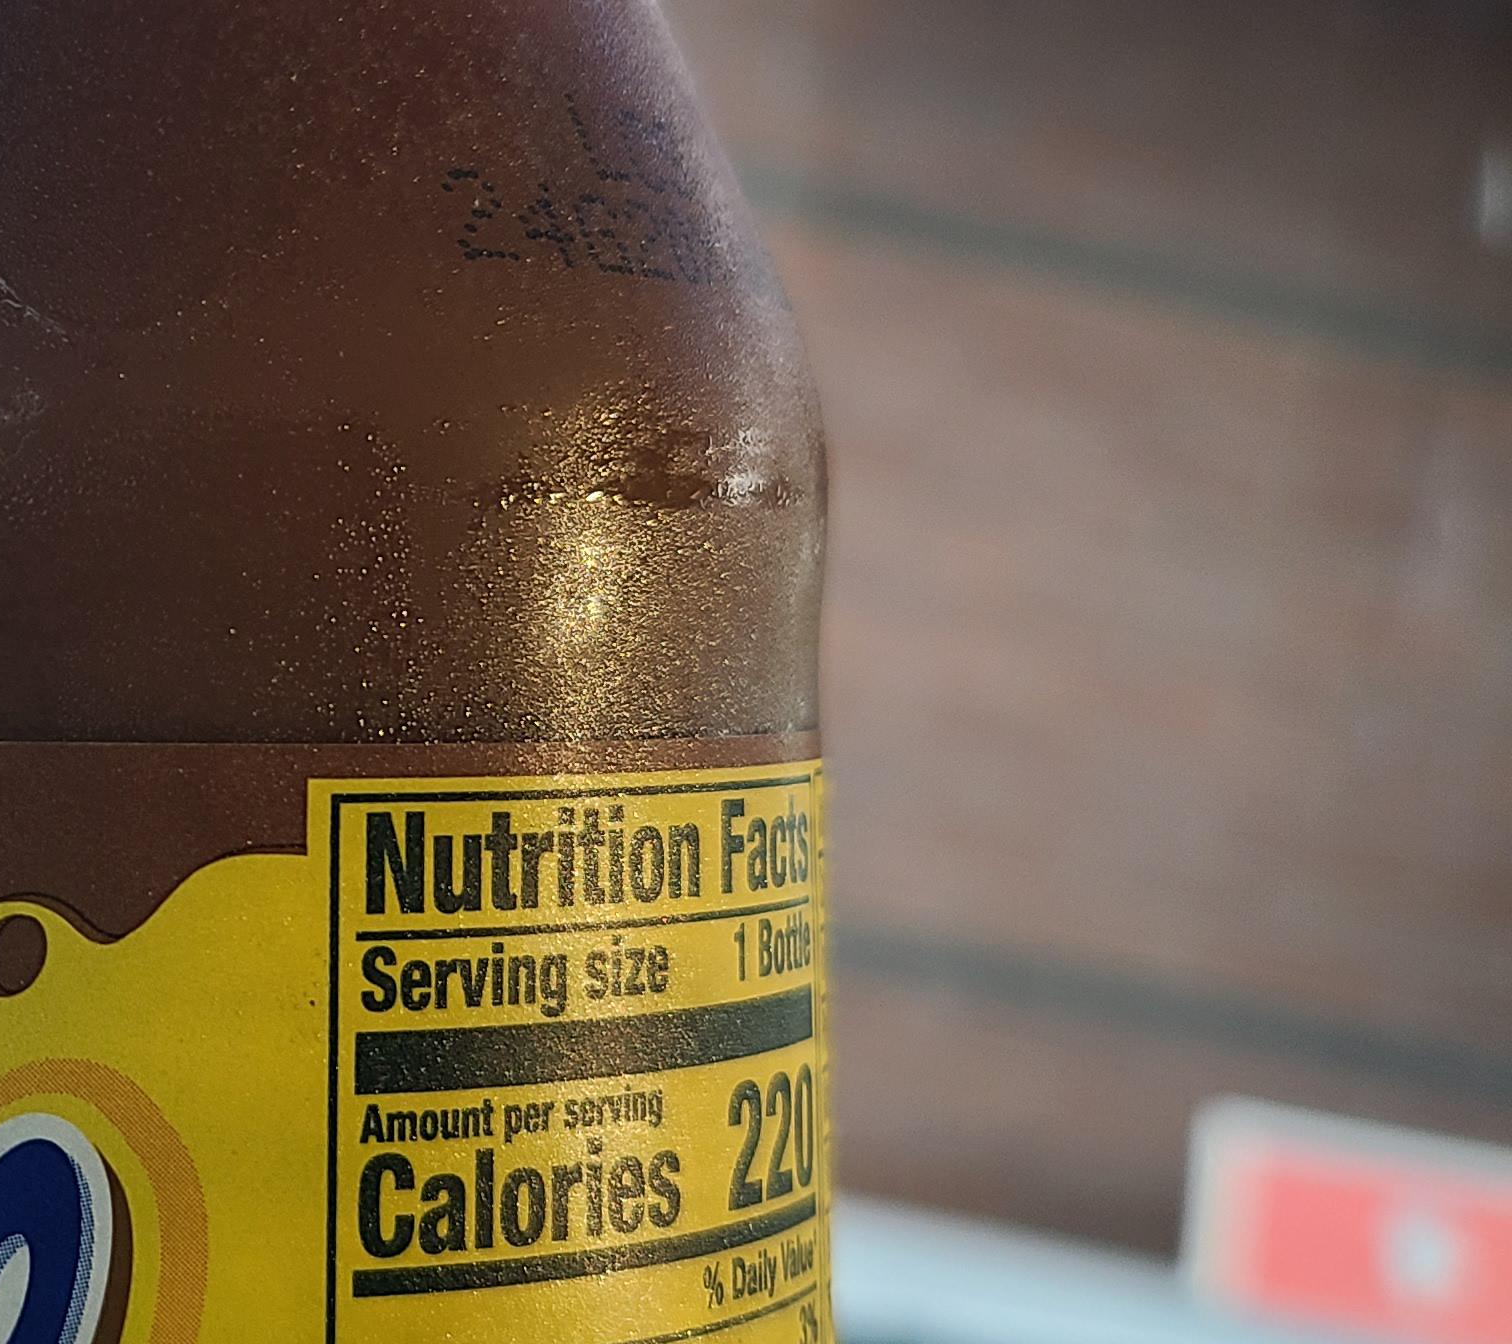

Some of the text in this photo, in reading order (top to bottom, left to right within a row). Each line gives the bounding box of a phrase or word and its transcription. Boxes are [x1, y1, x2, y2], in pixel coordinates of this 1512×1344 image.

[365, 794, 808, 915] Nutrition Facts
[361, 911, 811, 1017] Serving size 1 Bottle
[358, 1063, 813, 1258] Calories 220
[360, 1085, 663, 1143] Amount per serving
[732, 1248, 777, 1300] Daily
